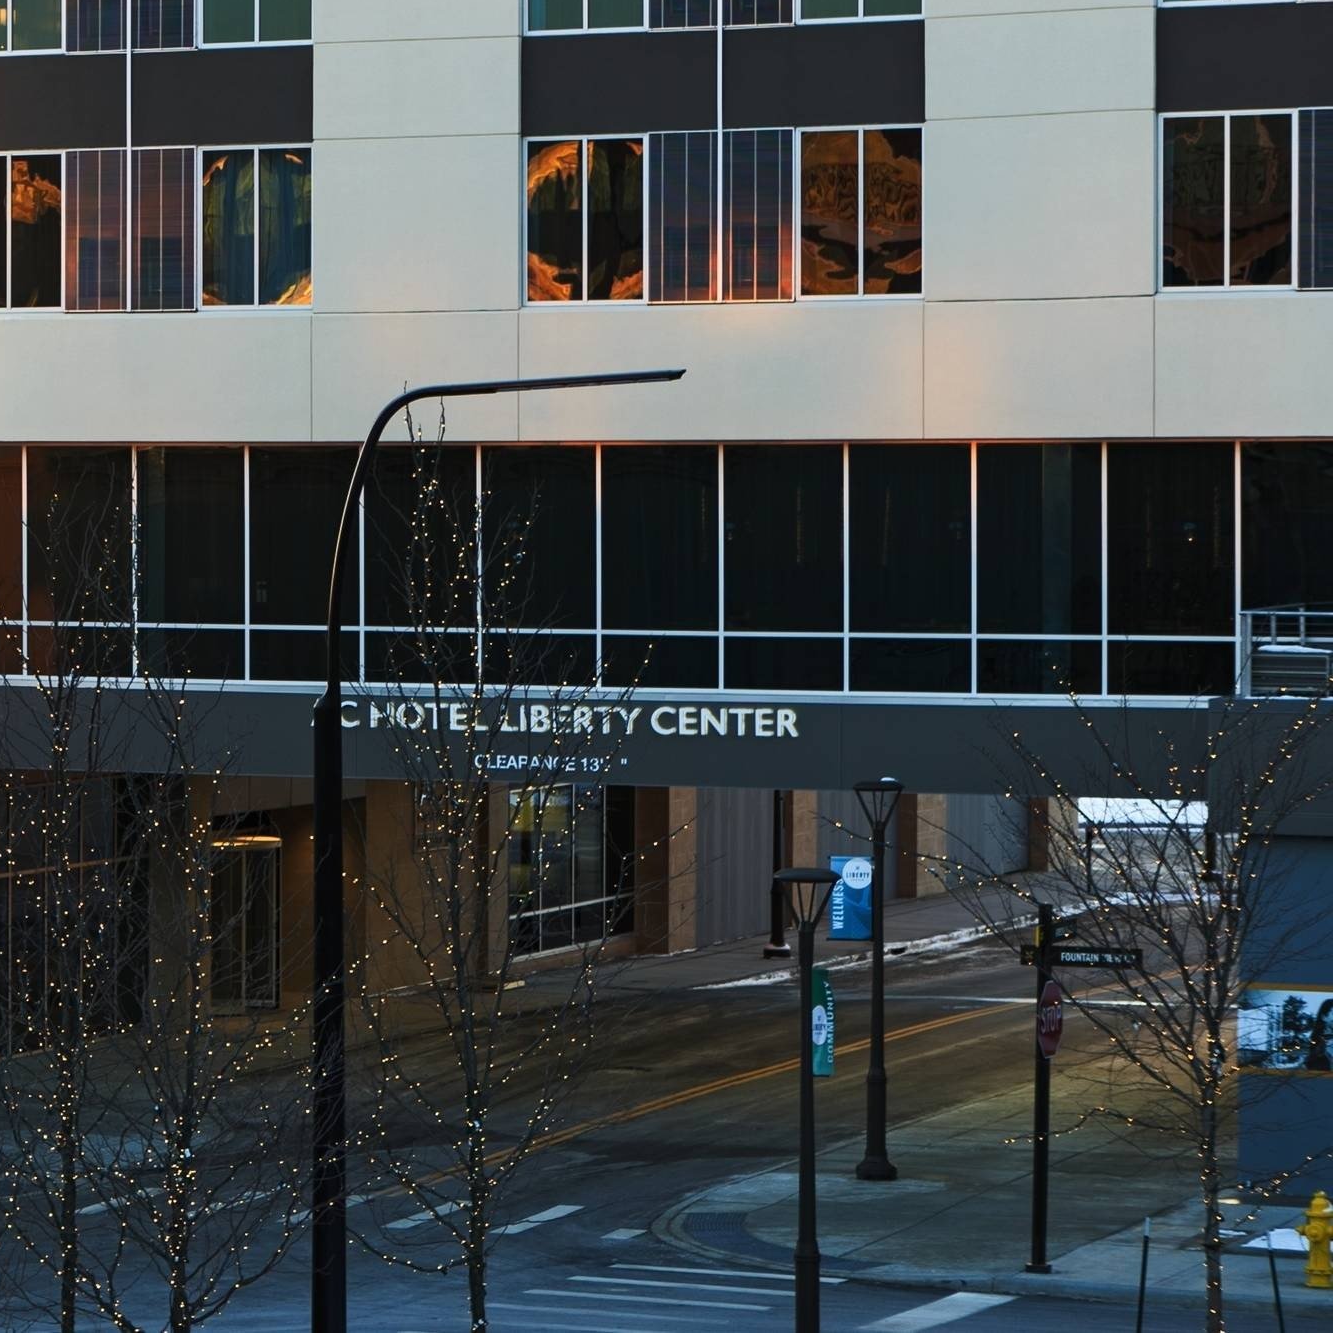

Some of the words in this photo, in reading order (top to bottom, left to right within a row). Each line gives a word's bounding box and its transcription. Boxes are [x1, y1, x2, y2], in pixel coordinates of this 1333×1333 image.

[369, 700, 489, 732] HOTEL
[499, 704, 643, 735] LIBERTY
[650, 705, 799, 738] CENTER
[832, 878, 845, 930] WELLNESS
[1060, 951, 1099, 963] FOUNTAIN
[824, 980, 834, 1064] COMMUNITY
[1040, 1006, 1062, 1035] STOP
